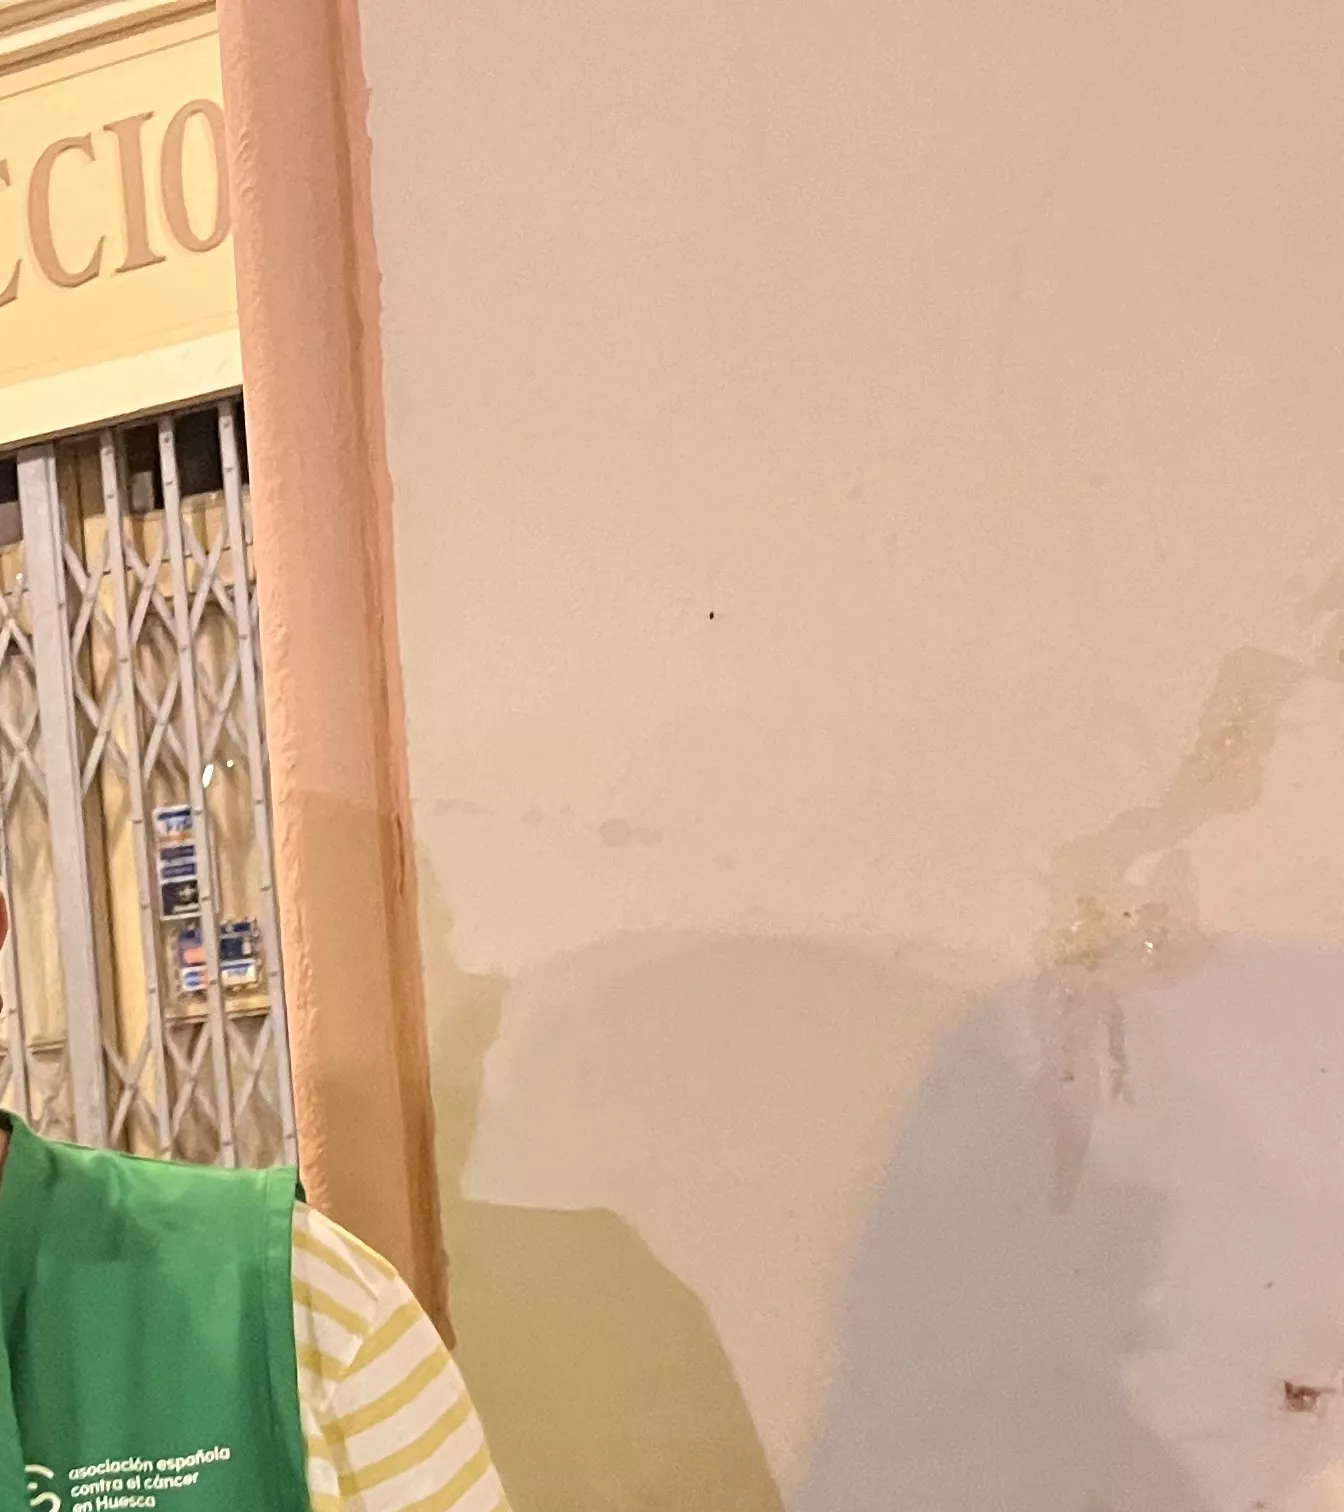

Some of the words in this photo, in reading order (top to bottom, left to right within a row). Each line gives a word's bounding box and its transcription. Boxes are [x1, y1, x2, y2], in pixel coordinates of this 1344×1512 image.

[68, 1456, 153, 1480] asociación
[156, 1446, 231, 1472] española
[70, 1477, 123, 1497] contra
[126, 1475, 141, 1490] el
[144, 1471, 199, 1490] cáncer
[96, 1495, 156, 1512] Huesca
